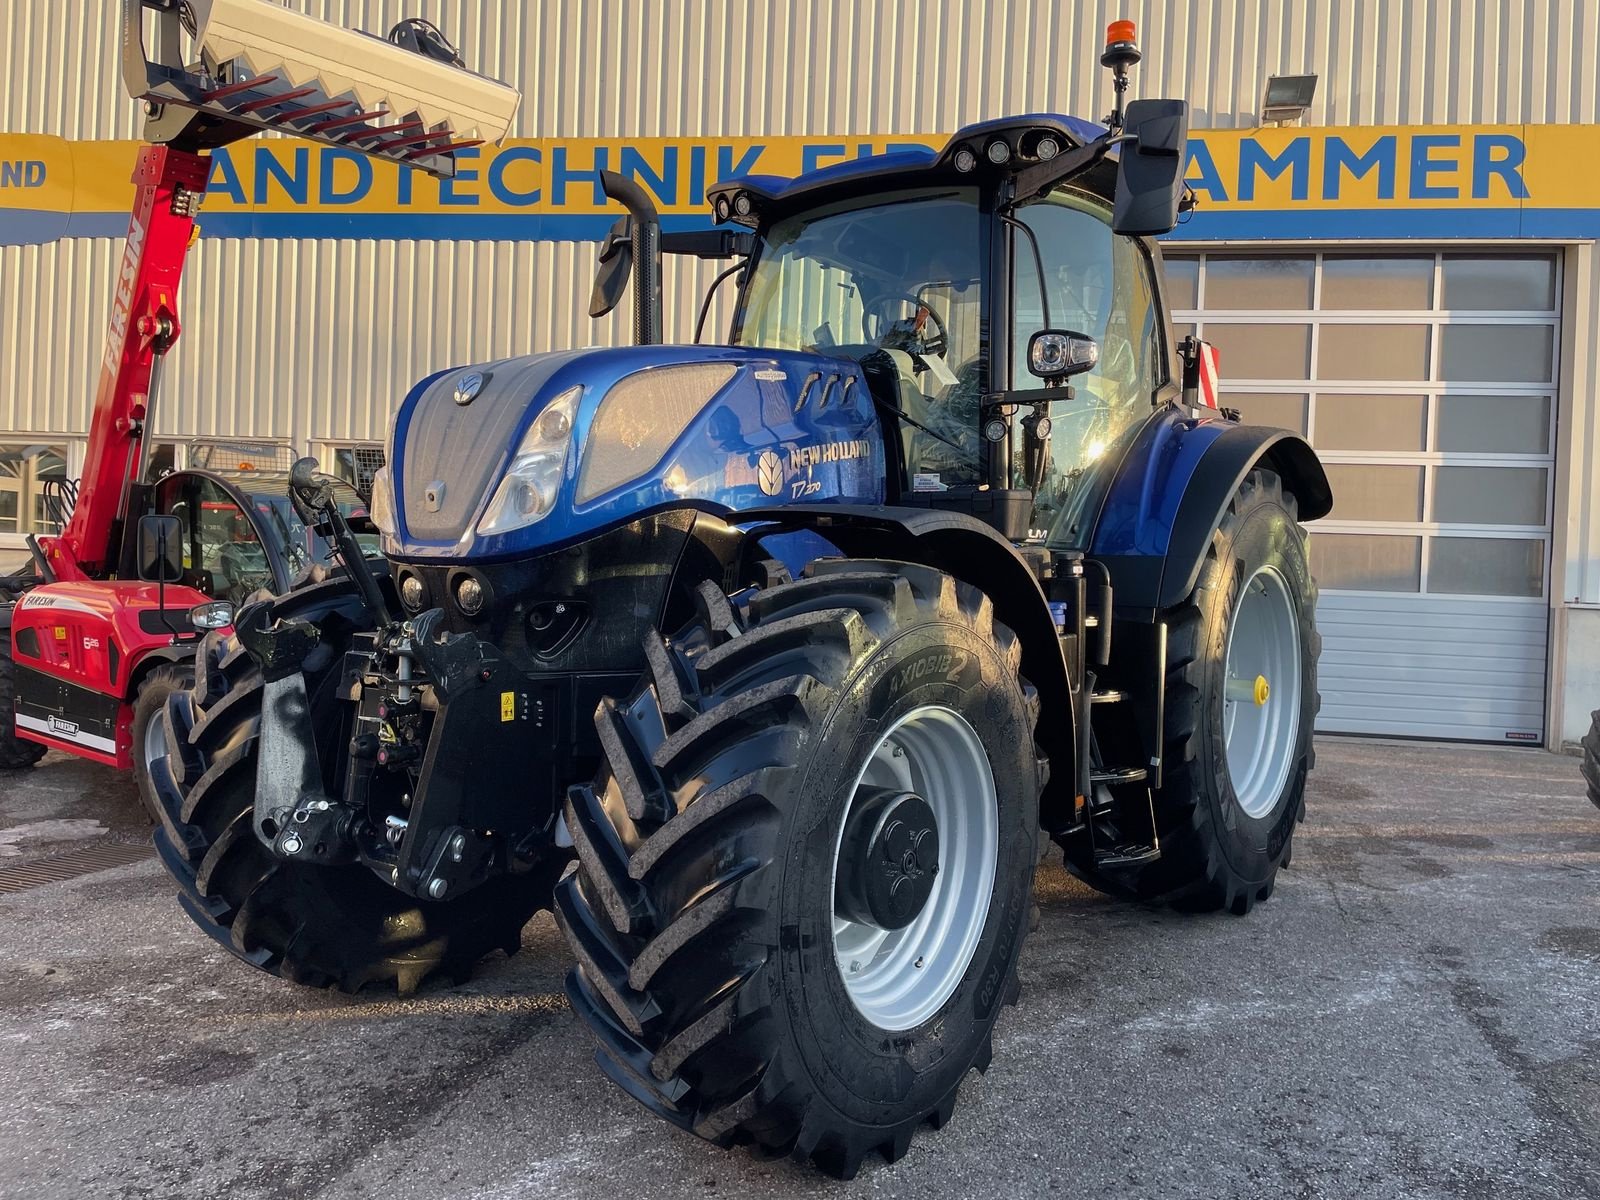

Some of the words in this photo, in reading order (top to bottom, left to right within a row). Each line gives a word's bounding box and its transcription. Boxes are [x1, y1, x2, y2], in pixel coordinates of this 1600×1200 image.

[201, 144, 767, 207] ANDTECHNIK
[104, 216, 145, 377] FARESIN
[789, 445, 820, 471] NEW
[822, 440, 870, 464] HOLLAND
[25, 595, 56, 607] FARESIN
[888, 653, 951, 700] AXIOBIB
[945, 651, 968, 682] 2
[55, 720, 76, 734] FARESIN
